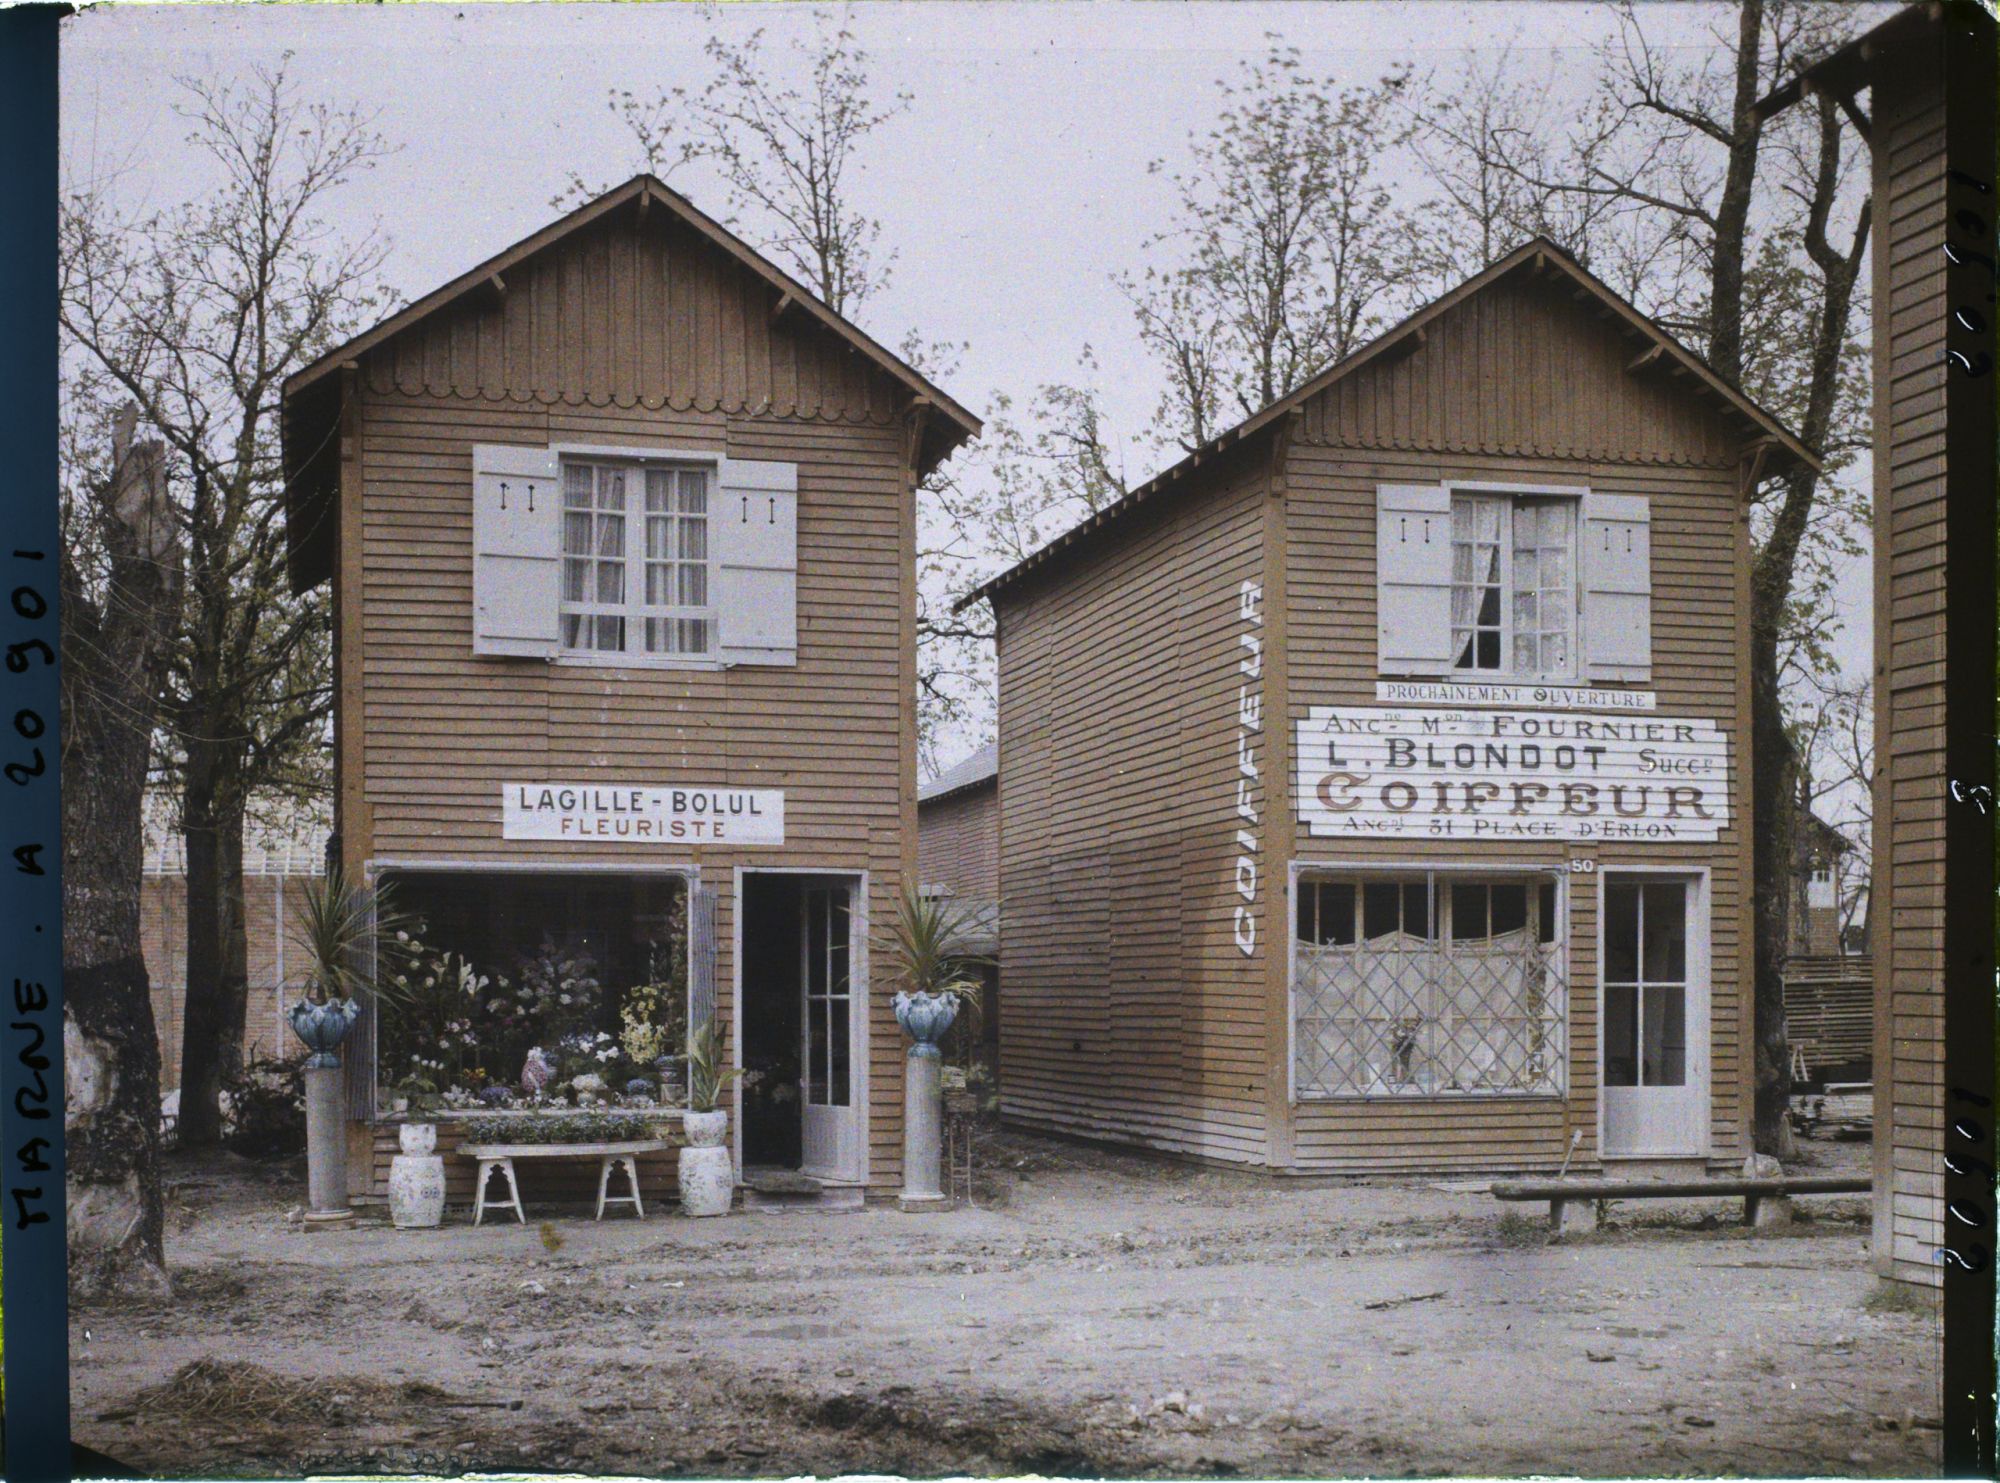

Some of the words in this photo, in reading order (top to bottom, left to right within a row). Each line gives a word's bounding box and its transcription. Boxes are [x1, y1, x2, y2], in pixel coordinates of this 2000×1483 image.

[1387, 684, 1521, 702] PROCHAINEMENT
[1533, 687, 1646, 707] OUVERTURE
[1491, 715, 1697, 742] FOURNIER
[1234, 578, 1263, 958] COIFFEUR
[1328, 740, 1371, 768] L.
[1384, 737, 1607, 771] BLONDOT
[1316, 772, 1715, 819] COIFFEUR
[561, 818, 725, 838] FLEURISTE
[1429, 820, 1454, 836] 31
[1473, 821, 1558, 836] PLACE
[1578, 821, 1678, 838] D'ERLON
[12, 843, 46, 877] A
[1572, 860, 1594, 873] 50
[9, 976, 52, 1231] MARNE
